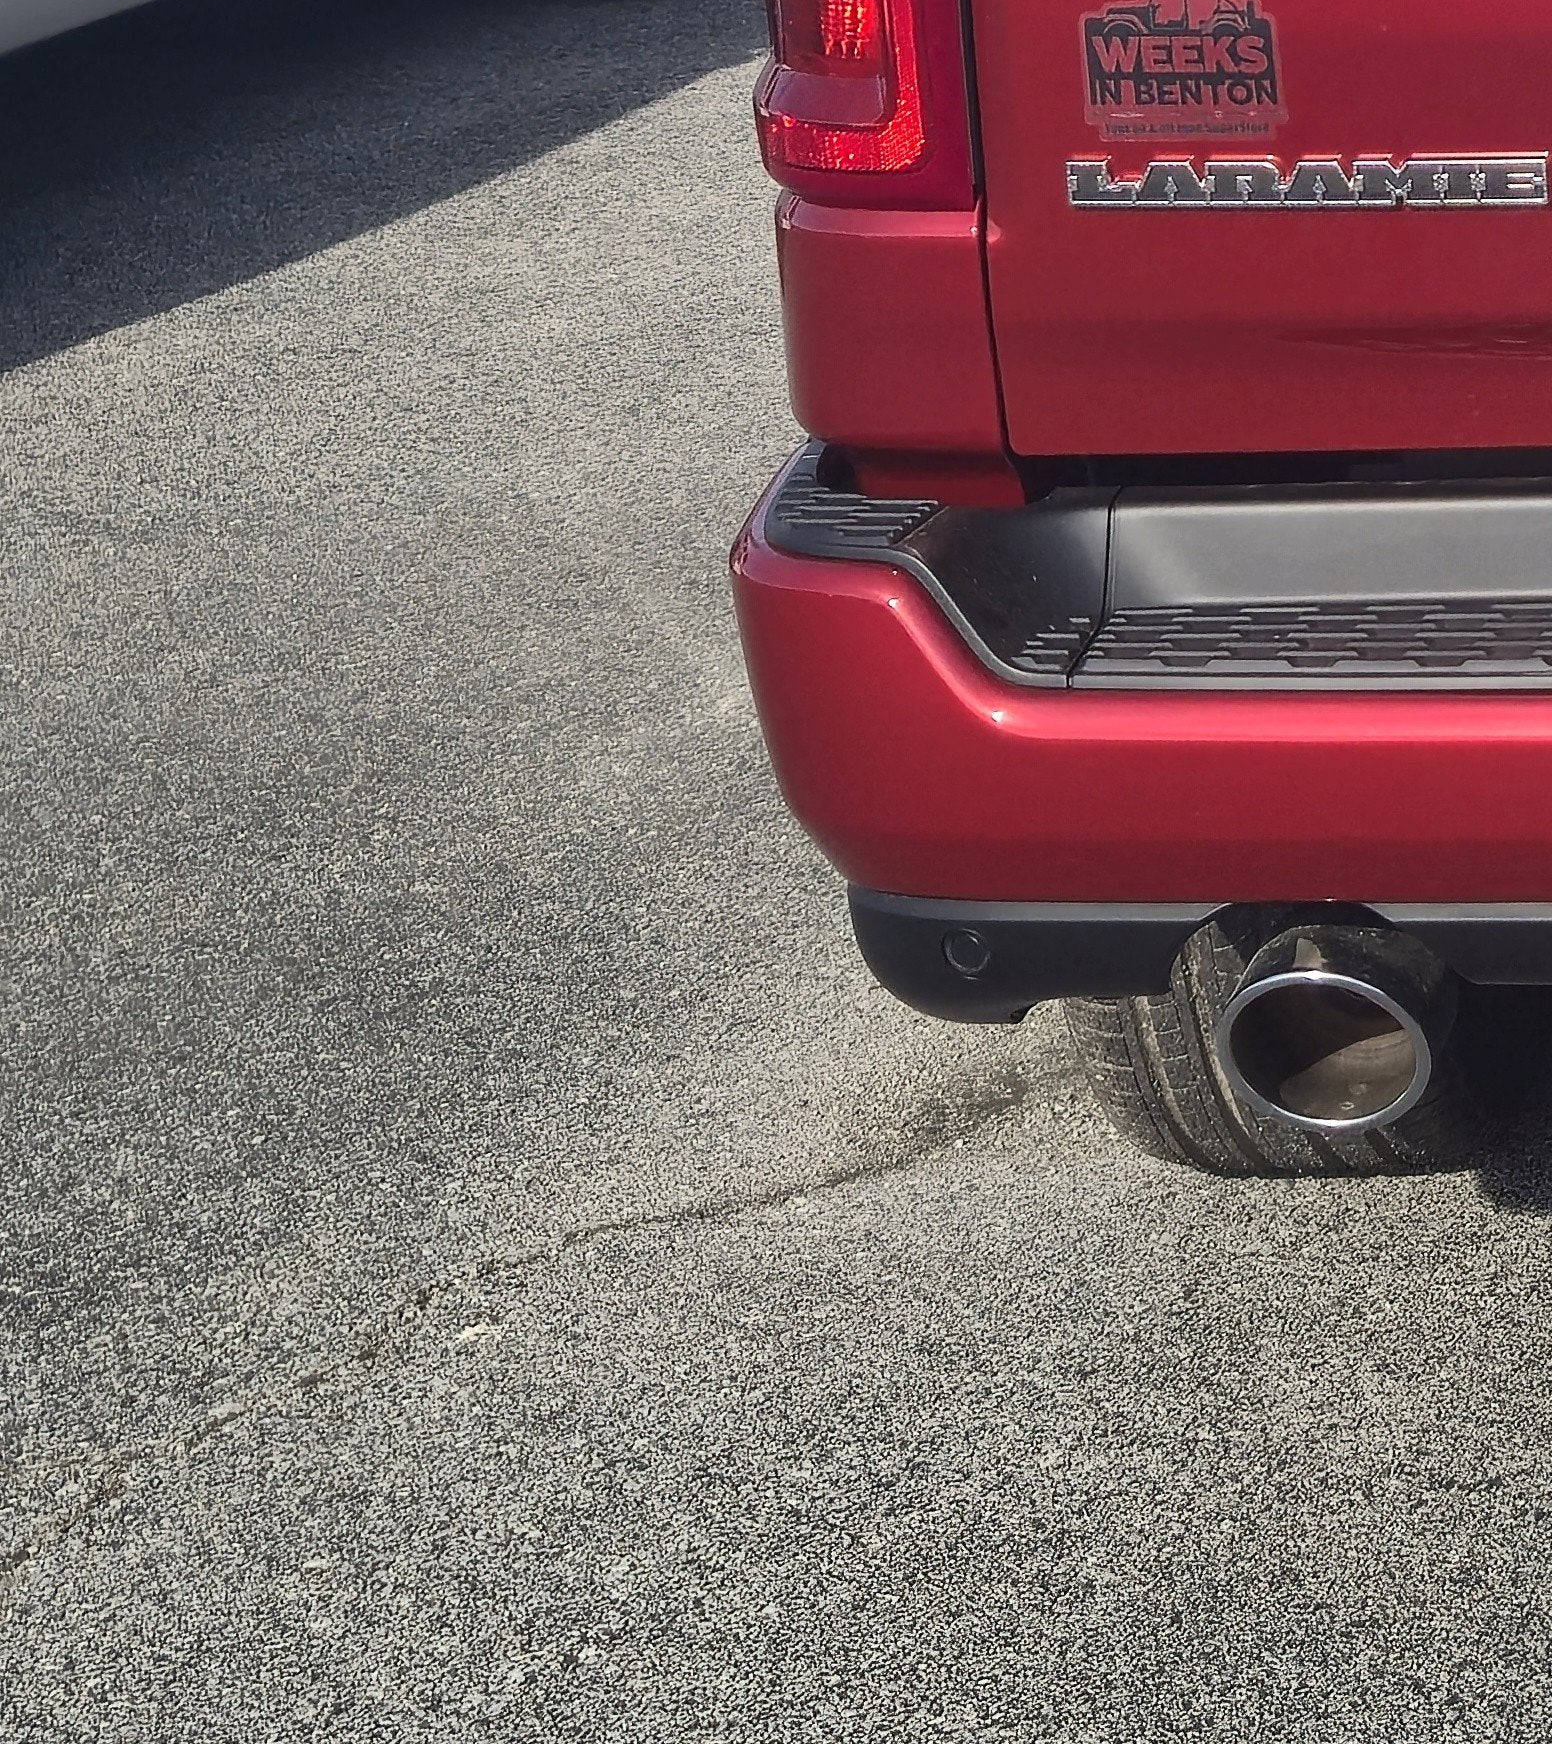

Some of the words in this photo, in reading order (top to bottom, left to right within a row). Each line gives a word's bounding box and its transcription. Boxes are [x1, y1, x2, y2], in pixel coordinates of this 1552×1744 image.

[1091, 35, 1269, 74] WEEKS
[1089, 78, 1122, 106] IN
[1135, 78, 1279, 107] BENTON
[1065, 153, 1550, 206] LARAMIE
